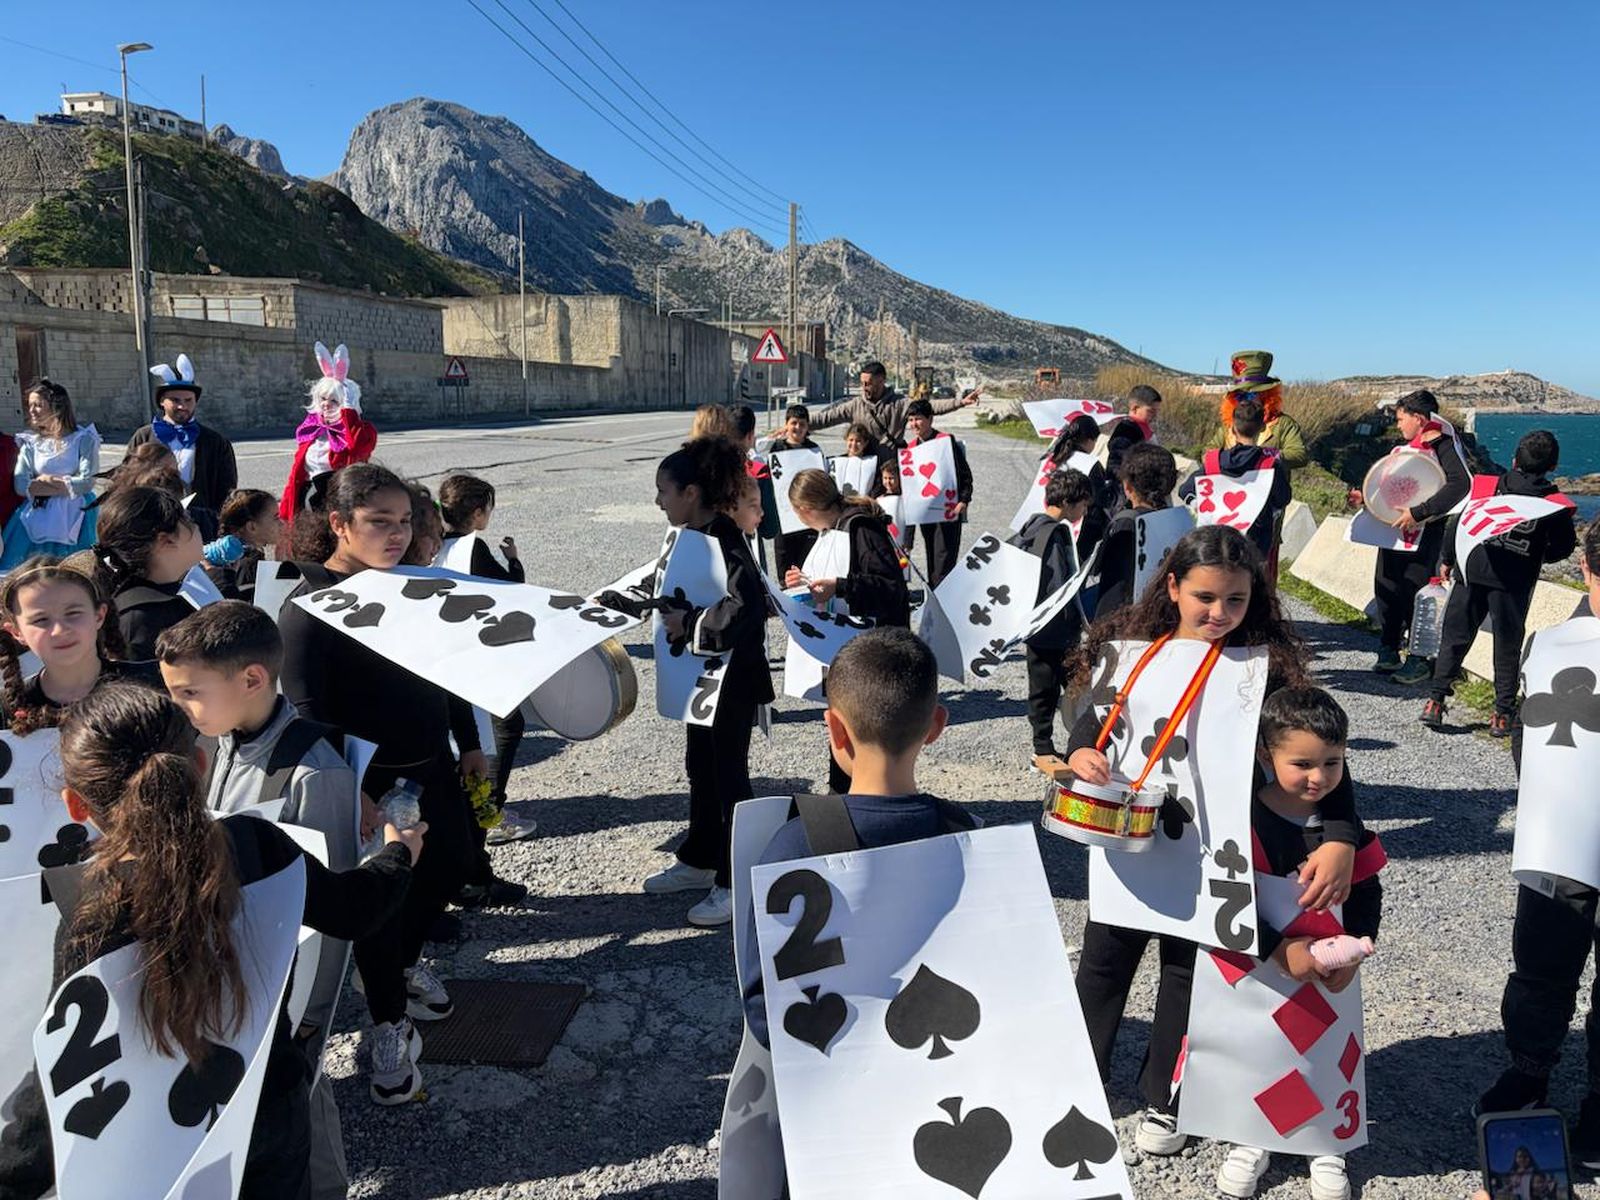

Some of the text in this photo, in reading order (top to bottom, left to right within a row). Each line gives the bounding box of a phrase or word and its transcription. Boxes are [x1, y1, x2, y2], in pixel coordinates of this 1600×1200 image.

[771, 454, 782, 469] A
[827, 460, 836, 473] A
[901, 450, 913, 465] 2
[1198, 478, 1214, 496] 3
[1138, 518, 1146, 547] 3
[658, 531, 677, 570] 2
[971, 535, 1000, 564] 2
[311, 589, 358, 613] 3
[579, 607, 628, 628] 3
[834, 612, 875, 629] 2
[971, 648, 1001, 678] 2
[1090, 643, 1120, 705] 2
[690, 676, 718, 720] 2
[766, 869, 845, 981] 2
[1209, 878, 1255, 951] 2
[47, 975, 121, 1098] 2
[1333, 1090, 1360, 1140] 3
